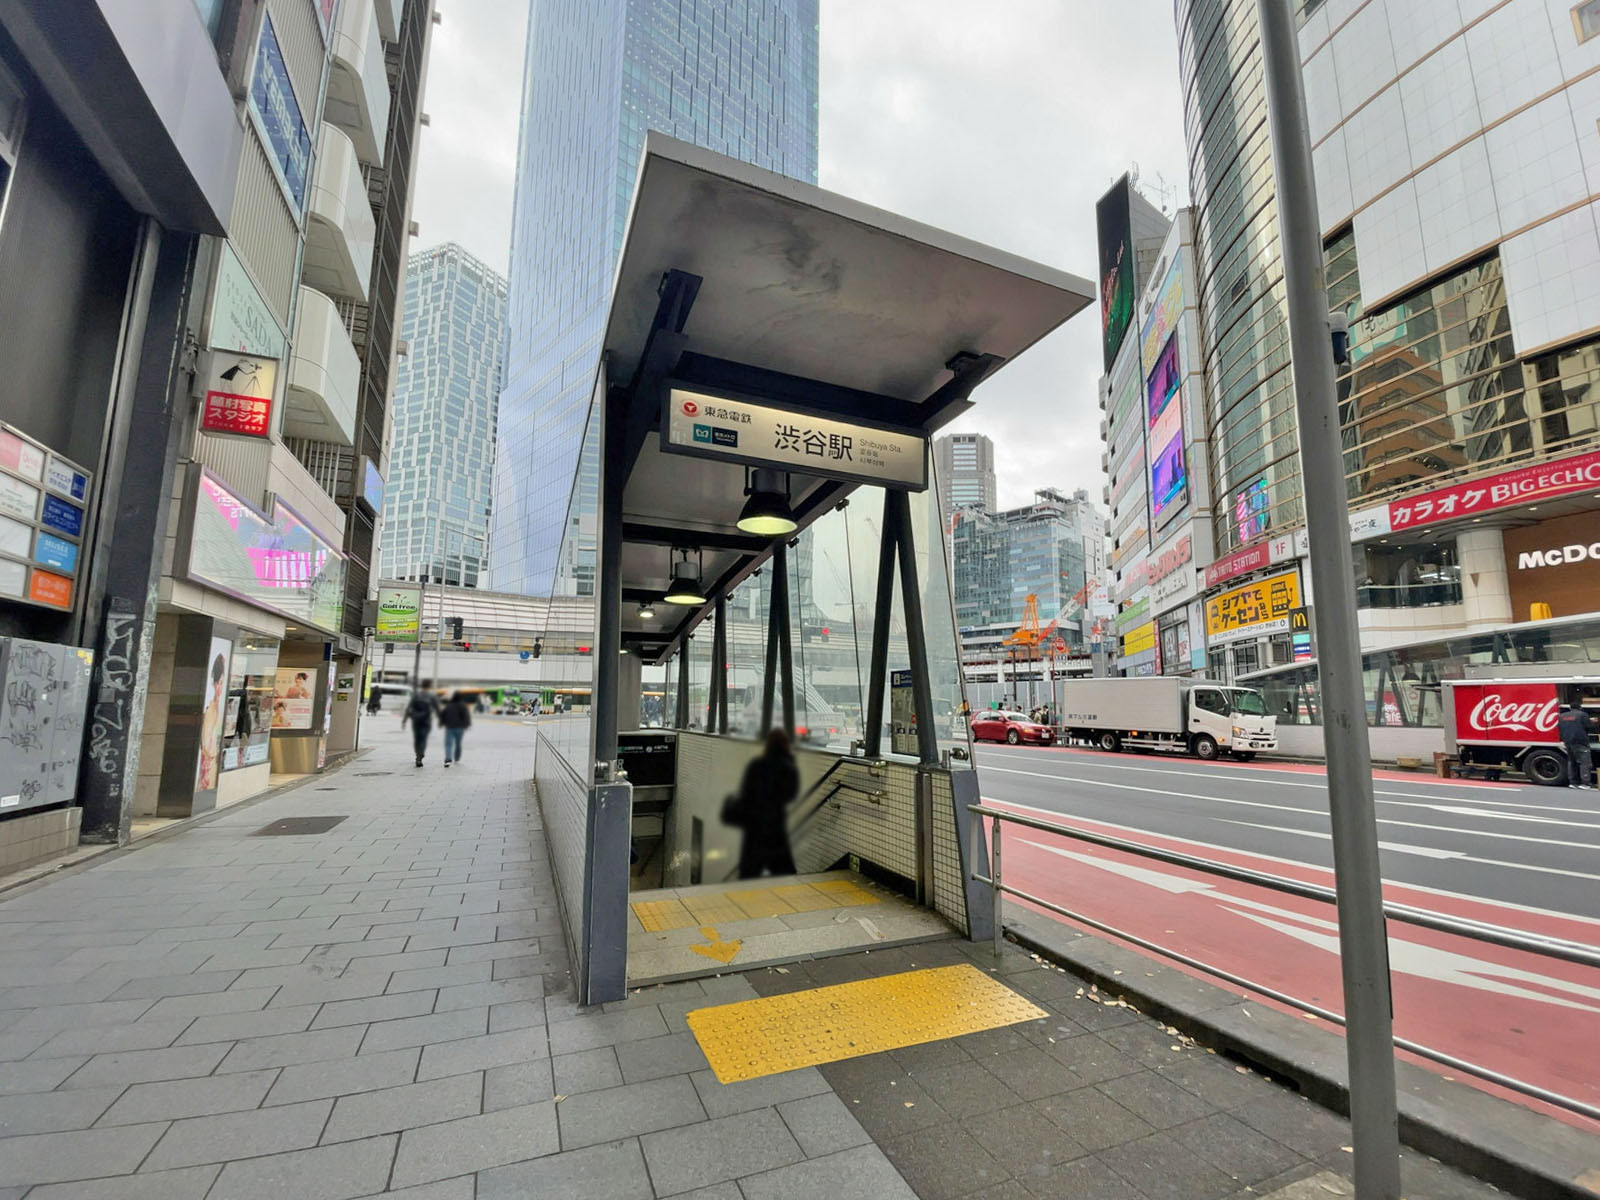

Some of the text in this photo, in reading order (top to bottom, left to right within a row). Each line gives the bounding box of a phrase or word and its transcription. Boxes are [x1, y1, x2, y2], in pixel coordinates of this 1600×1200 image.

[208, 408, 265, 425] スタジオ
[704, 405, 752, 424] 東急電鉄
[774, 423, 853, 461] 渋谷駅
[859, 438, 887, 451] Shibuya
[1392, 462, 1600, 526] カラオケ BIG ECHO
[1233, 551, 1260, 571] STATION
[1275, 542, 1286, 556] 1F
[1222, 589, 1263, 611] シブヤで
